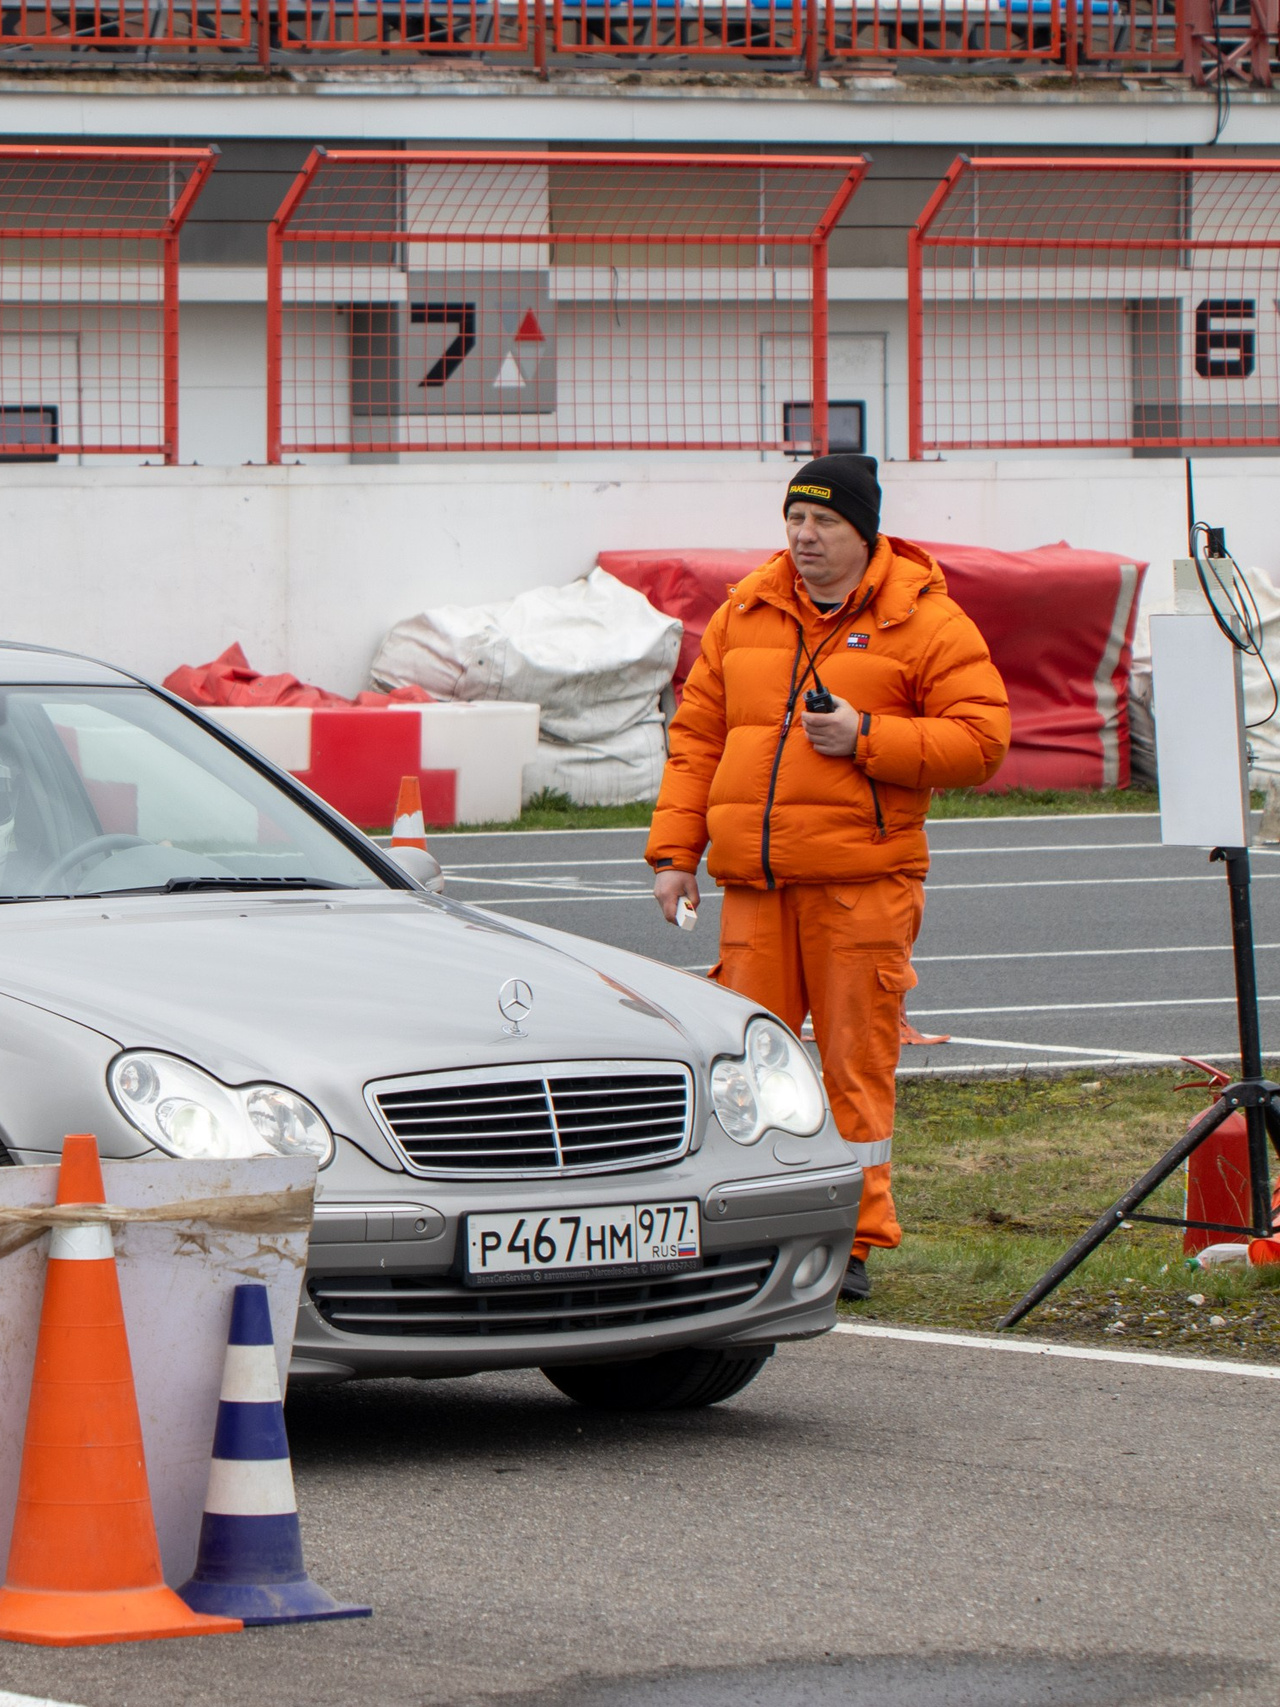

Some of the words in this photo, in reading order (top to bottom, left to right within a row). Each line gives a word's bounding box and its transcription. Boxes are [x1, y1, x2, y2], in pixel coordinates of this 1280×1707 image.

[410, 302, 477, 387] 7
[1195, 298, 1256, 380] 6
[638, 1206, 688, 1244] 977
[652, 1245, 677, 1258] RUS
